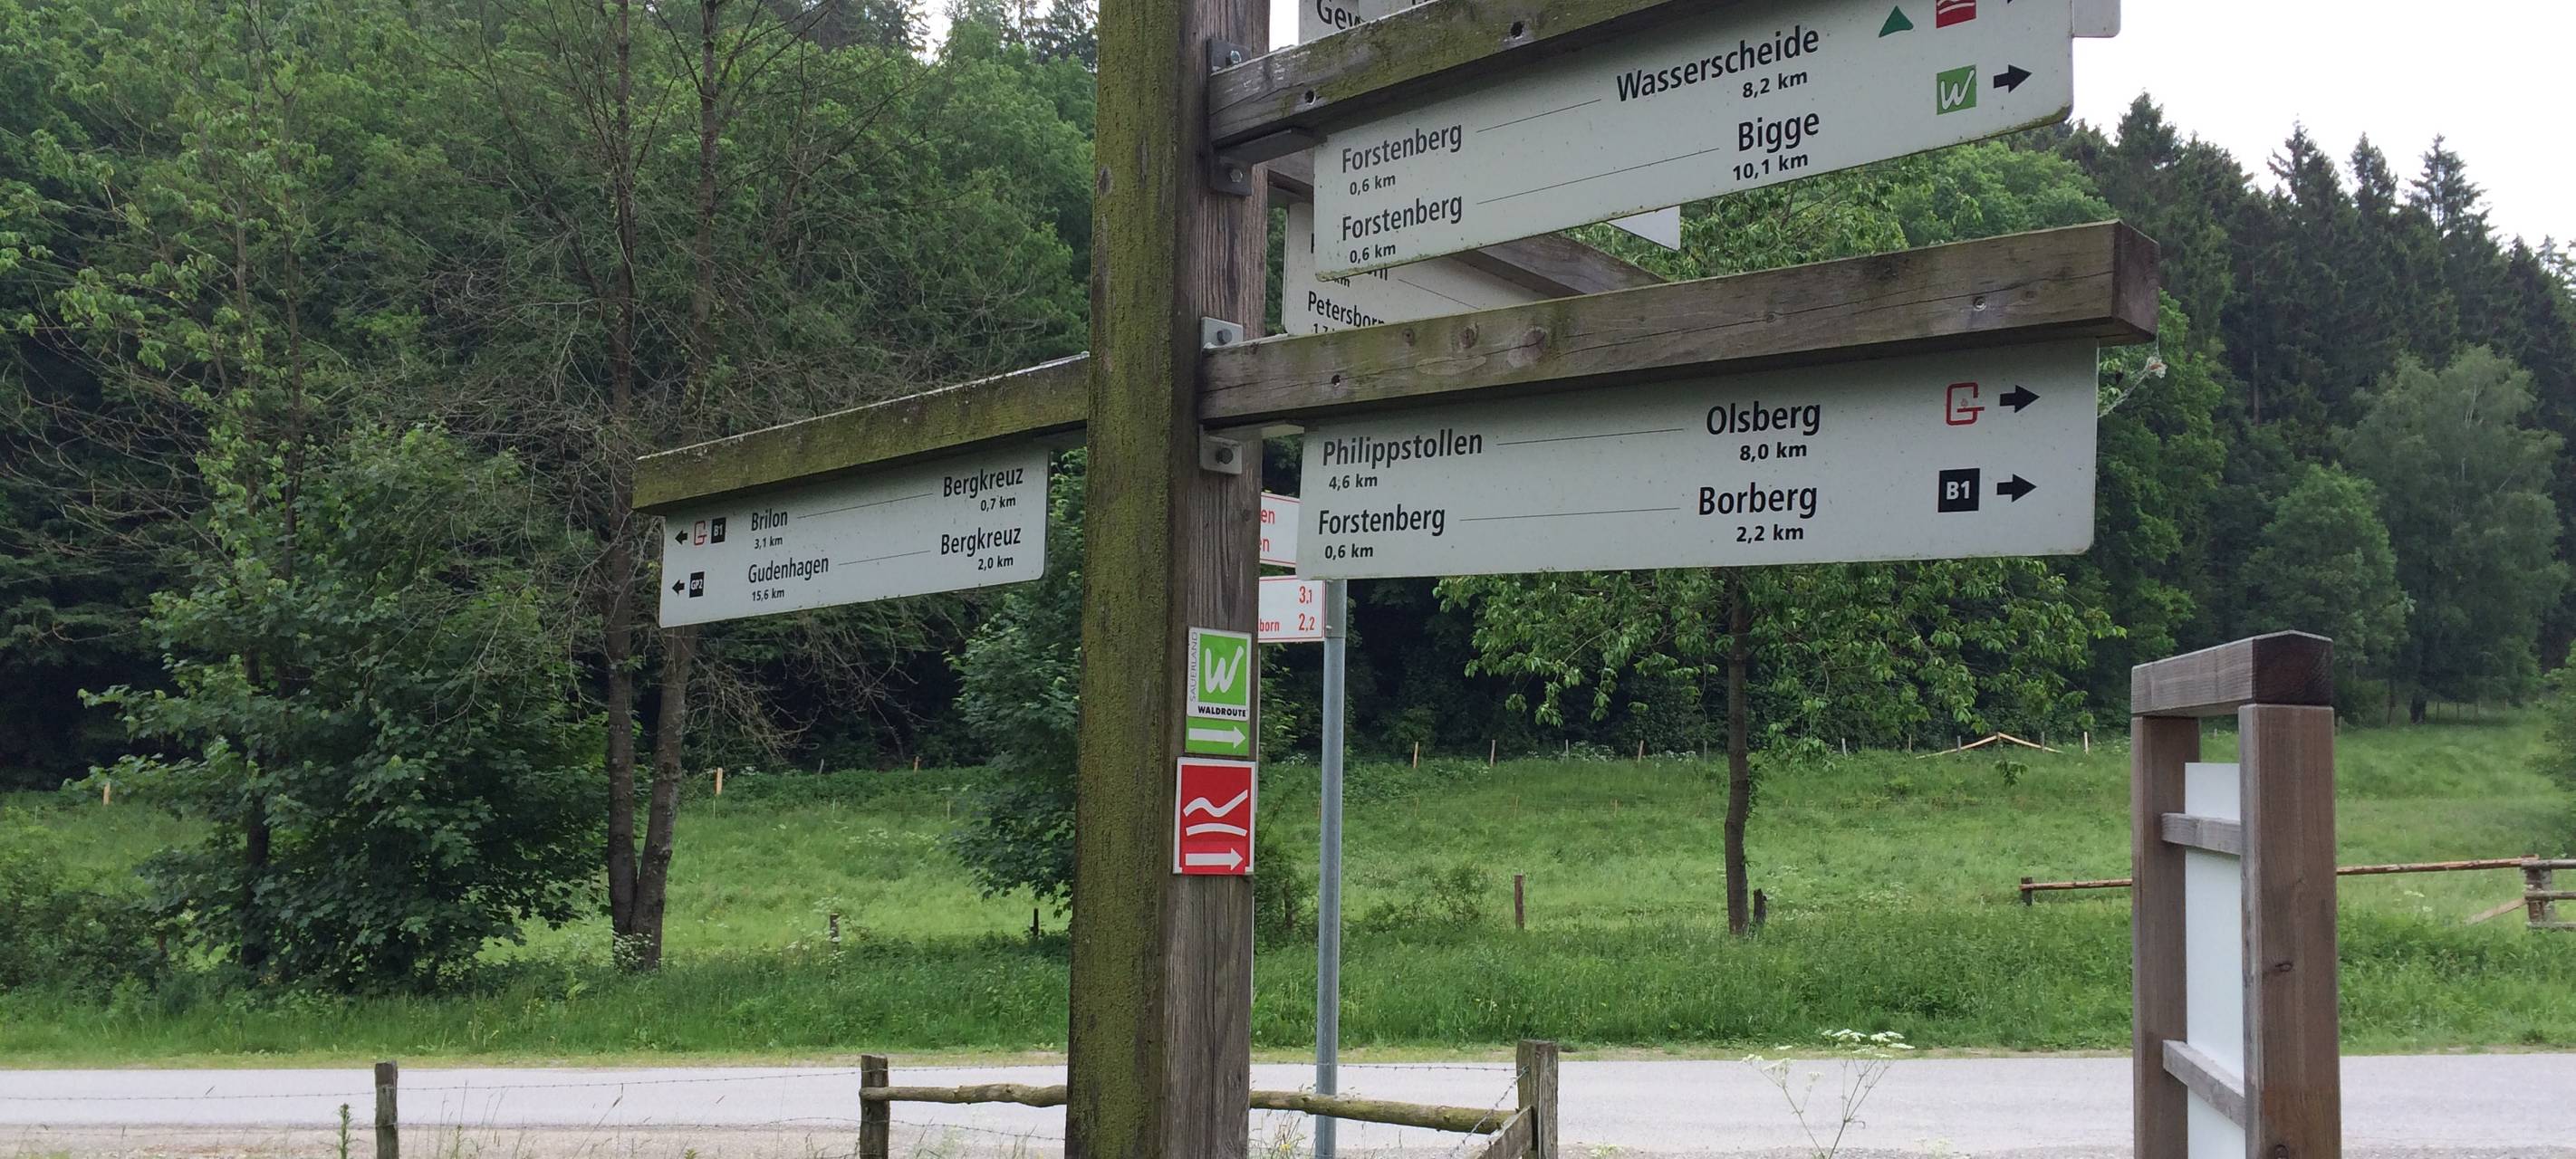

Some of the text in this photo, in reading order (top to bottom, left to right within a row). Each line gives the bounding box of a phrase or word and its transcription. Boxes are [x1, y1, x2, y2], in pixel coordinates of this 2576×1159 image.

[1341, 24, 1820, 173] Forstenberg Wasserscheide
[1349, 71, 1808, 196] 0,6 km 8,2 km
[1341, 112, 1820, 242] Forstenberg Bigge
[1349, 153, 1809, 264] 0,6 km 10,1 km
[1322, 428, 1483, 469] Philippstollen
[1706, 400, 1821, 436] Olsberg
[1329, 441, 1807, 491] 4,6 km 8,0 km
[714, 524, 724, 537] B1
[751, 508, 788, 532] Brilon
[943, 467, 1024, 498] Bergkreuz
[754, 495, 1016, 551] 3,1 km 0,7 km
[1318, 480, 1971, 537] Forstenberg Borberg B1
[691, 527, 1021, 590] GP2 Gudenhagen Bergkreuz
[1324, 523, 1804, 560] 0,6 km 2,2 km
[752, 554, 1014, 602] 15,6 km 2,0 km
[1299, 586, 1312, 605] 3,1
[1258, 613, 1315, 633] born 2,2
[1189, 631, 1198, 703] SAUERLAND
[1197, 705, 1246, 717] WALDROUTE
